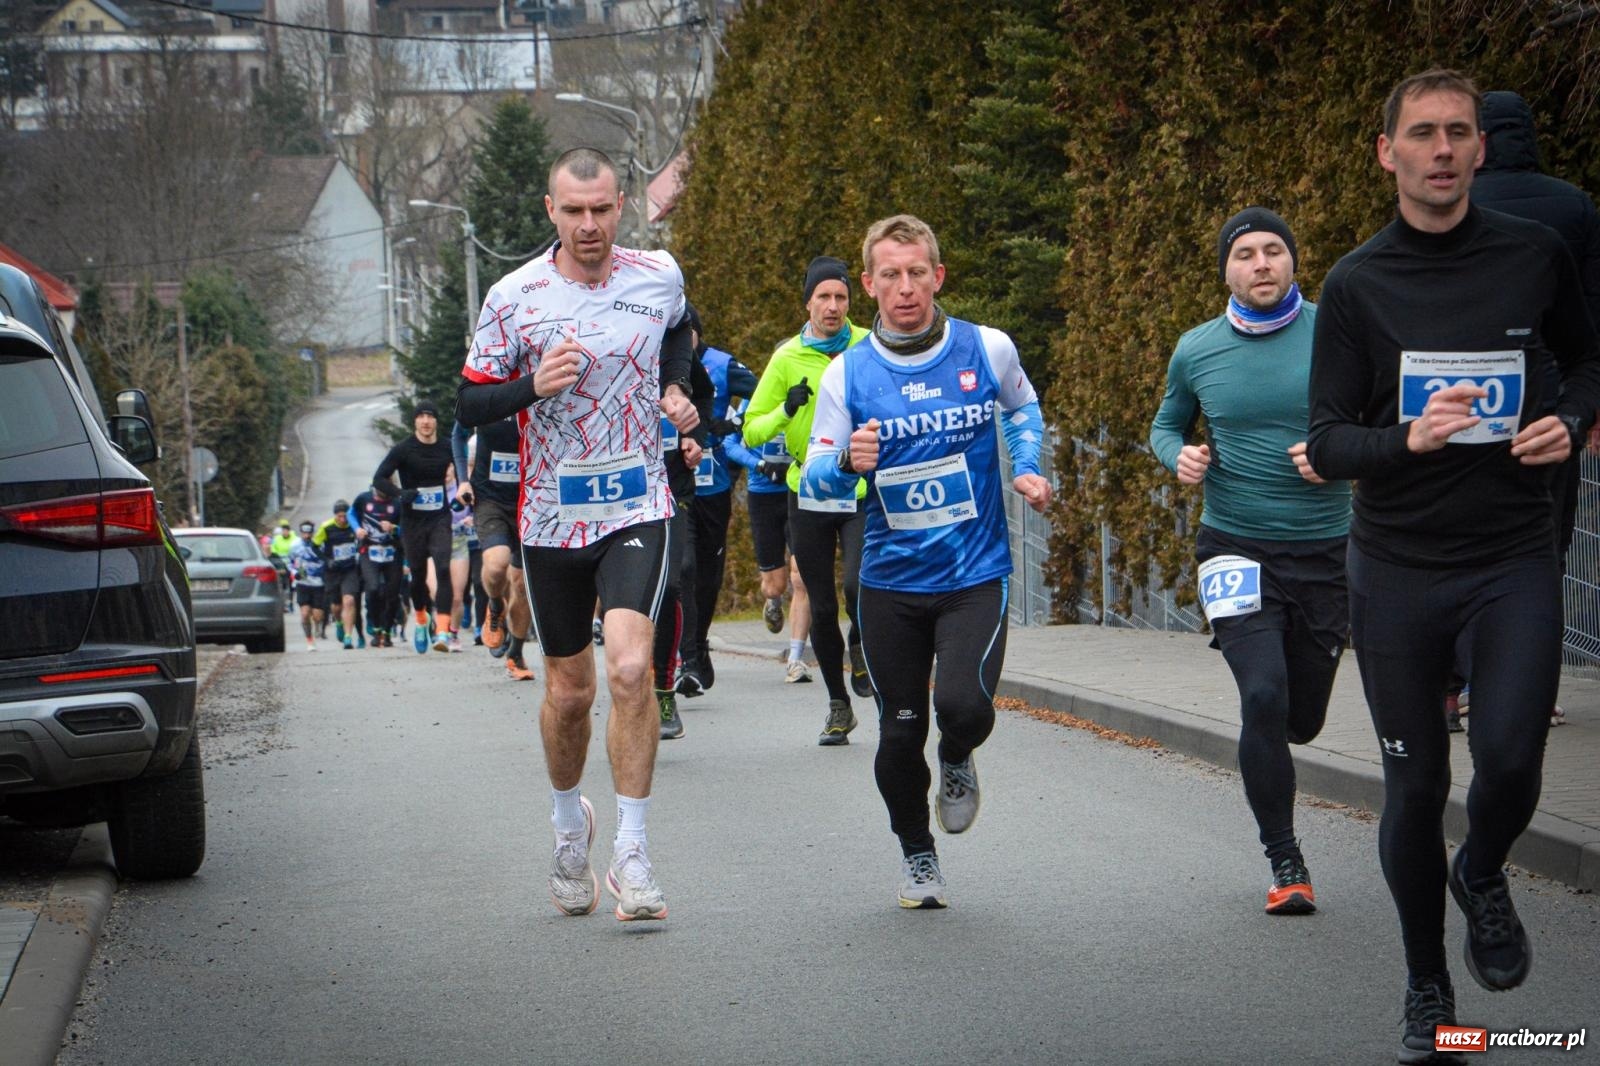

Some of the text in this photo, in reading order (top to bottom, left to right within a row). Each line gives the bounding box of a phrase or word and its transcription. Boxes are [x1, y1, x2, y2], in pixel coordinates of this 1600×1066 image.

[613, 300, 664, 320] DYCZUŚ
[858, 399, 994, 441] UNNERS
[945, 432, 975, 443] TEAM
[499, 461, 520, 473] 12
[585, 473, 624, 502] 15
[906, 480, 945, 510] 60
[422, 494, 436, 504] 93
